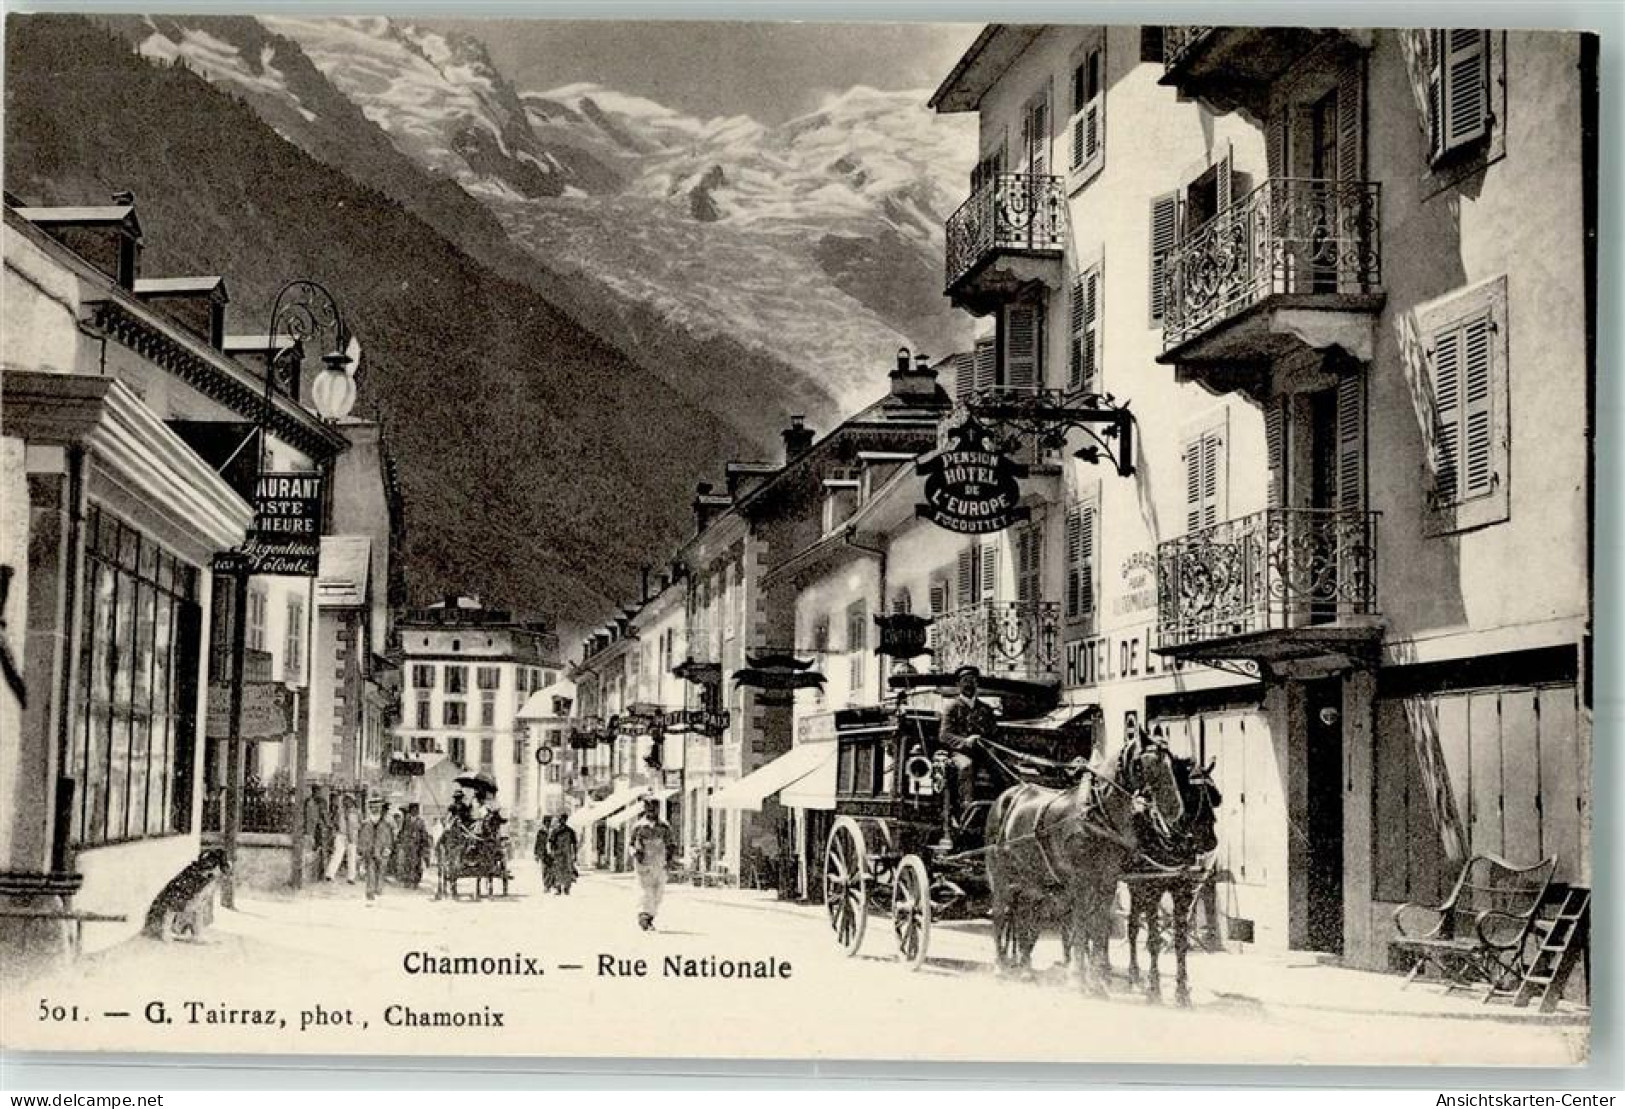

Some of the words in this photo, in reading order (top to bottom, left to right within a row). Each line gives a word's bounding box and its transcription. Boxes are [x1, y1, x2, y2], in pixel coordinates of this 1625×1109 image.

[941, 451, 999, 468] PENSION
[964, 485, 981, 496] DE
[931, 489, 1011, 516] L'EUROPE
[1120, 638, 1139, 678] DE
